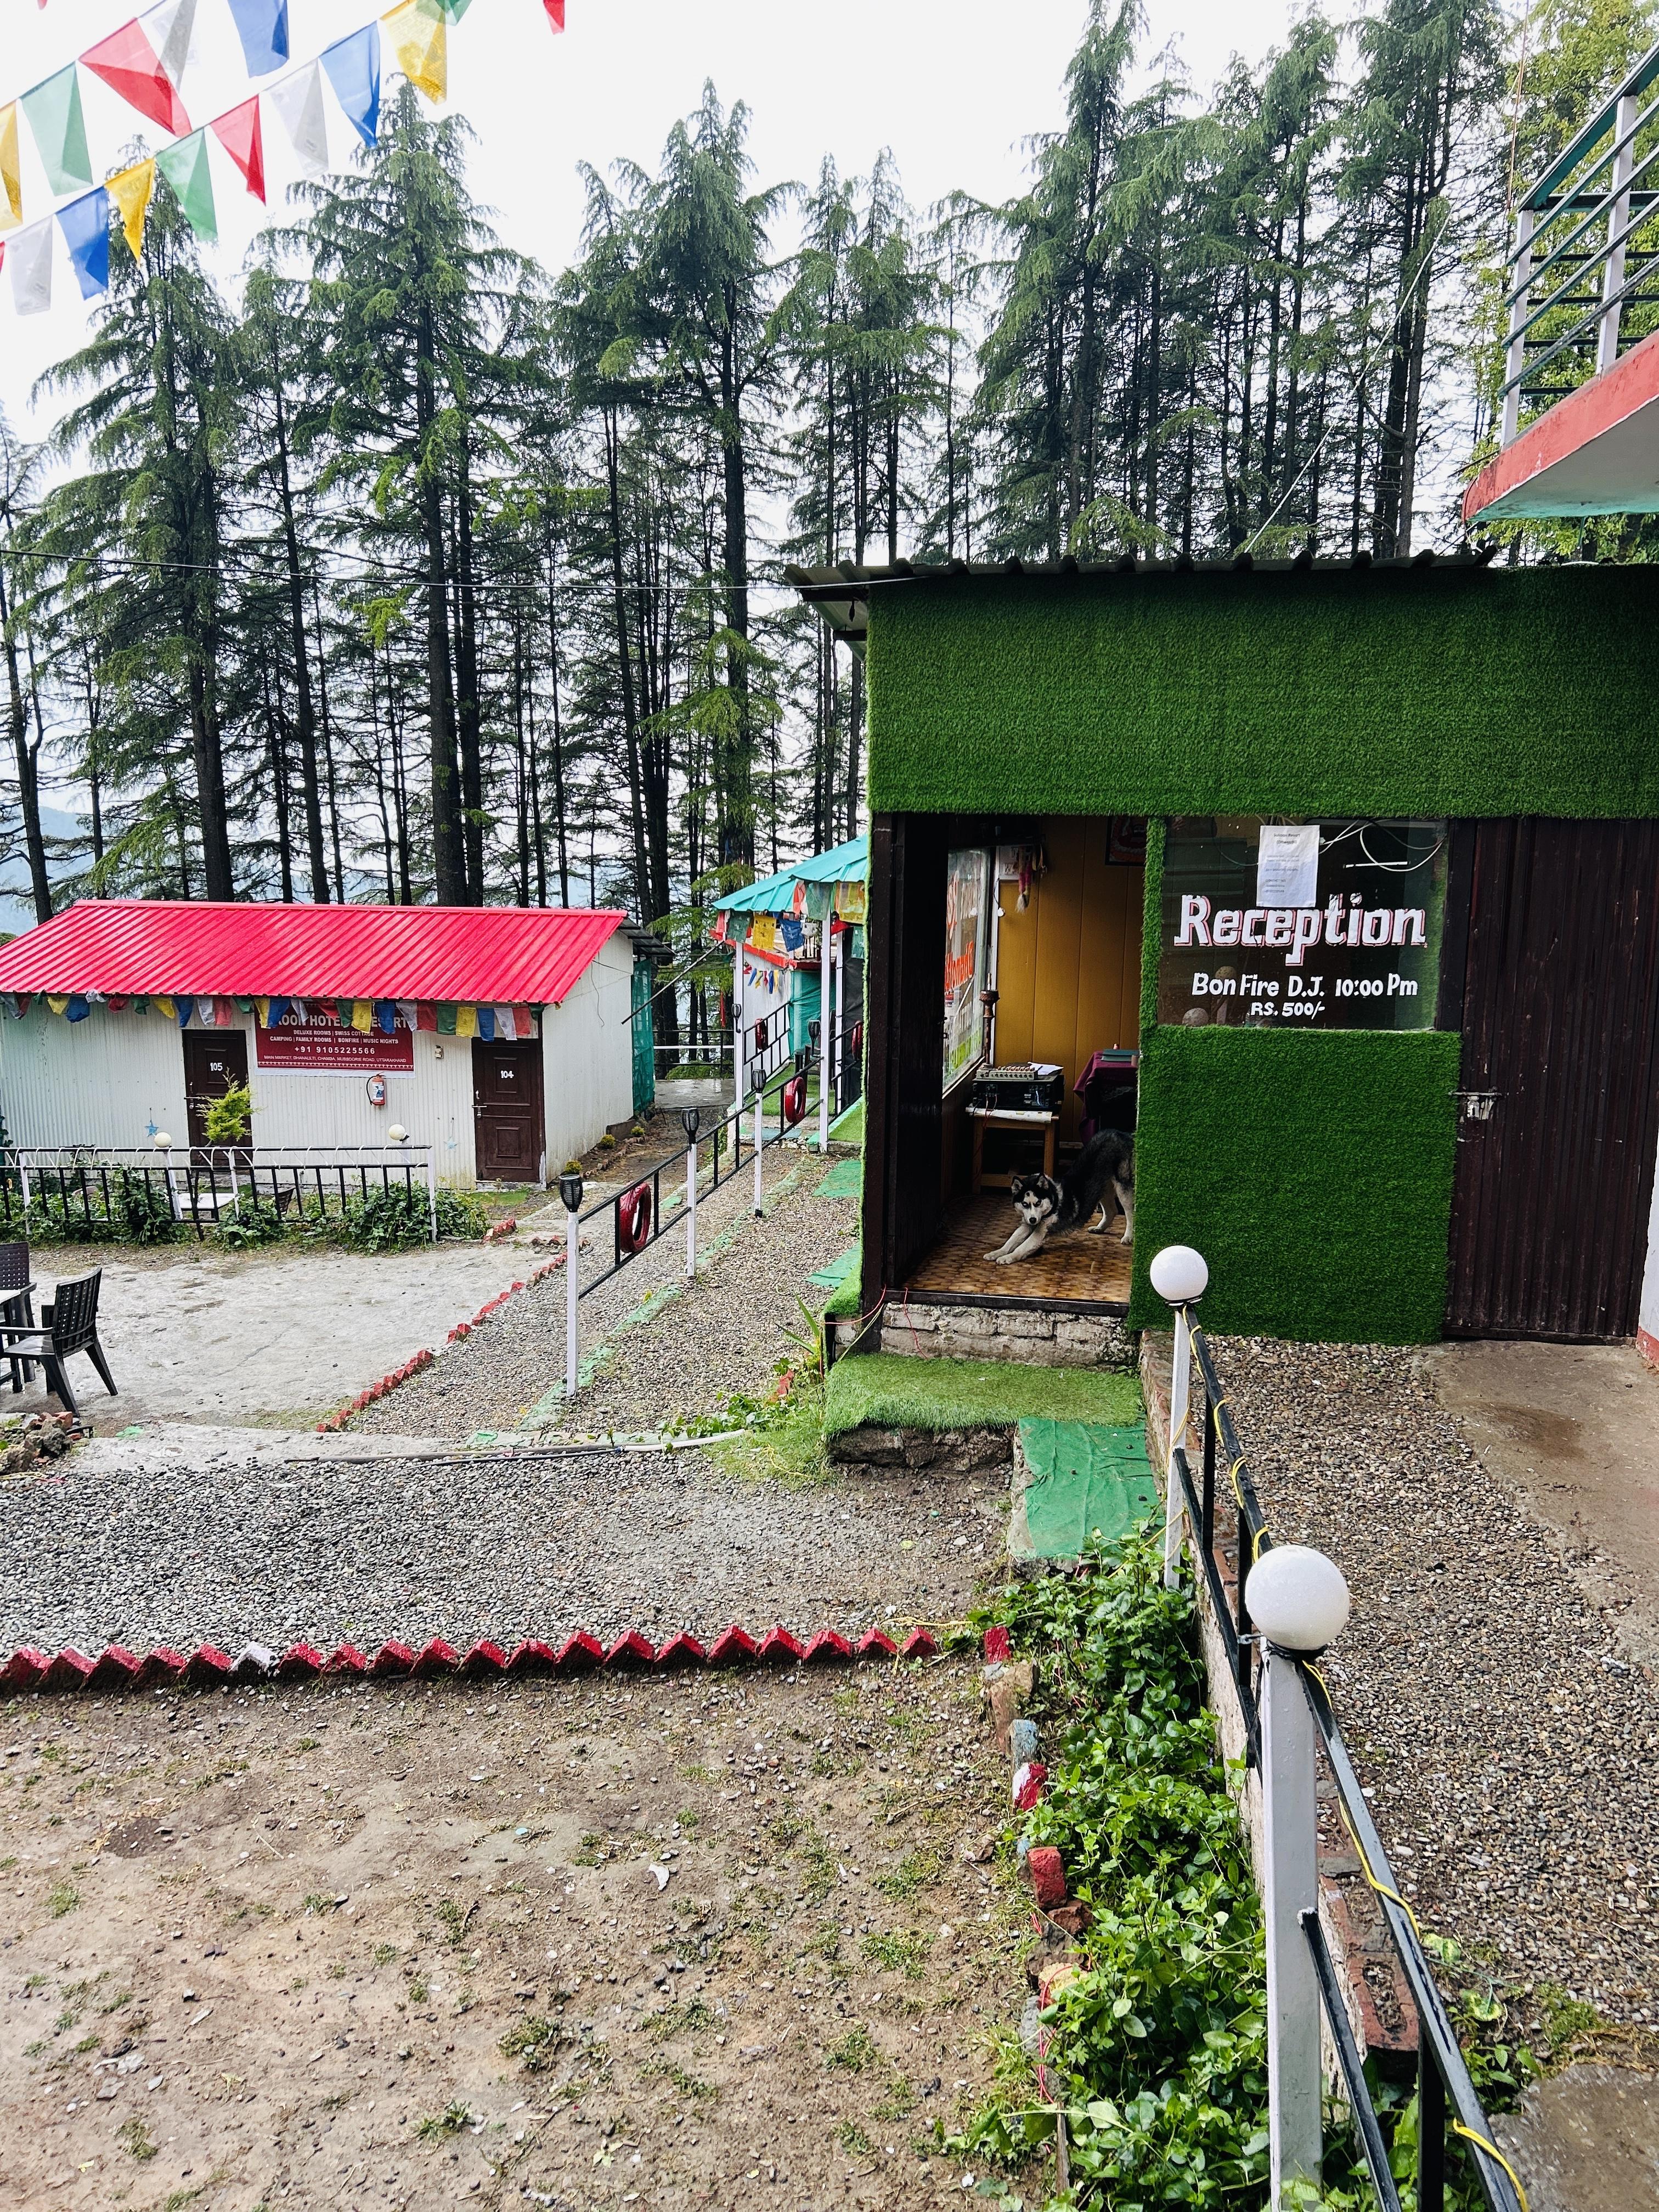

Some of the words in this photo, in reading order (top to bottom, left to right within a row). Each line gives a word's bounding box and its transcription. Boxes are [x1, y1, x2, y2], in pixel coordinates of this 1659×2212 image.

[1174, 893, 1427, 966] Reception
[1288, 975, 1325, 997] D.J.
[1335, 979, 1384, 997] 10:00
[1386, 973, 1418, 996] Pm
[1250, 1002, 1279, 1016] RS.
[1282, 1001, 1325, 1020] 500/-
[309, 1014, 343, 1026] HOTE
[316, 1046, 375, 1054] 9105225566
[210, 1062, 223, 1071] 105
[500, 1070, 514, 1079] 104
